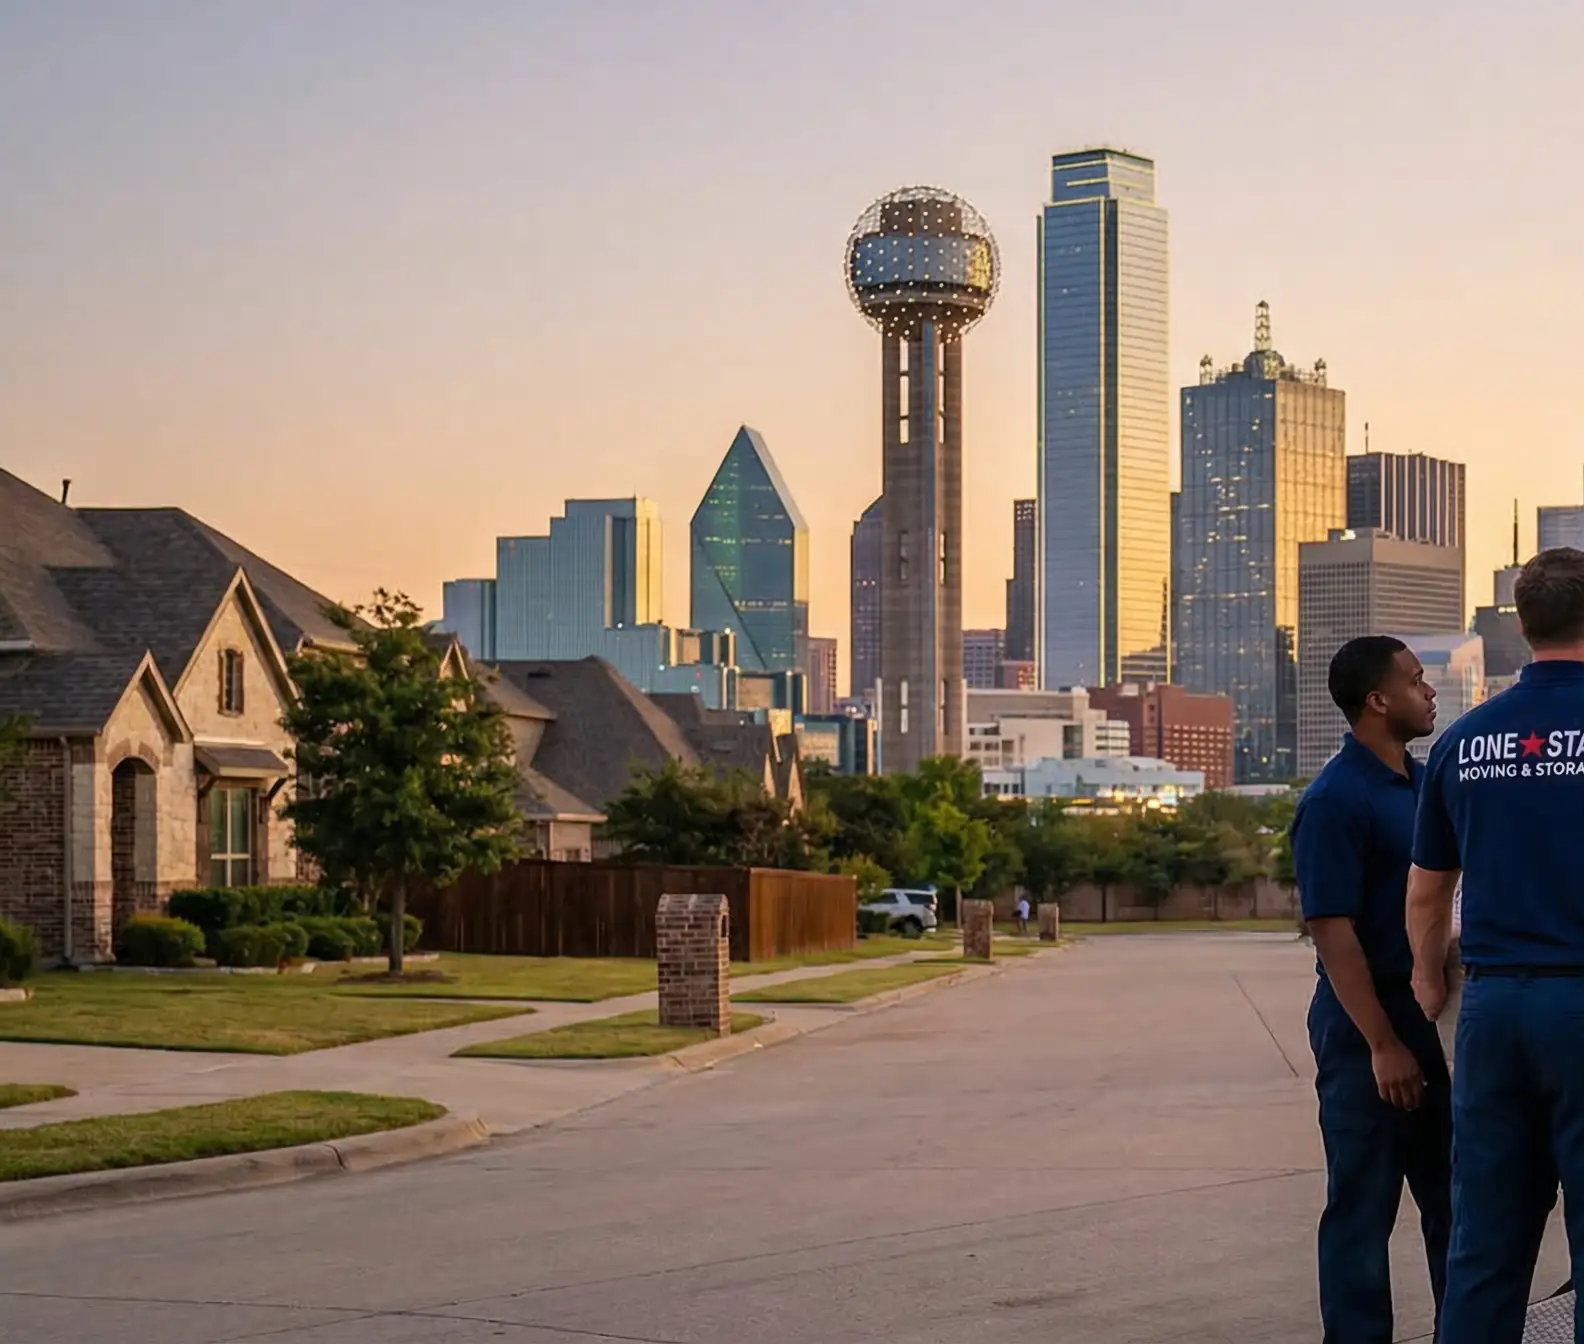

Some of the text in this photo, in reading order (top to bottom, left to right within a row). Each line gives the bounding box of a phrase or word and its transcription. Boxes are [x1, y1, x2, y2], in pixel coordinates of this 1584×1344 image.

[1458, 732, 1519, 765] LONE
[1459, 763, 1517, 782] MOVING
[1521, 763, 1532, 777] &
